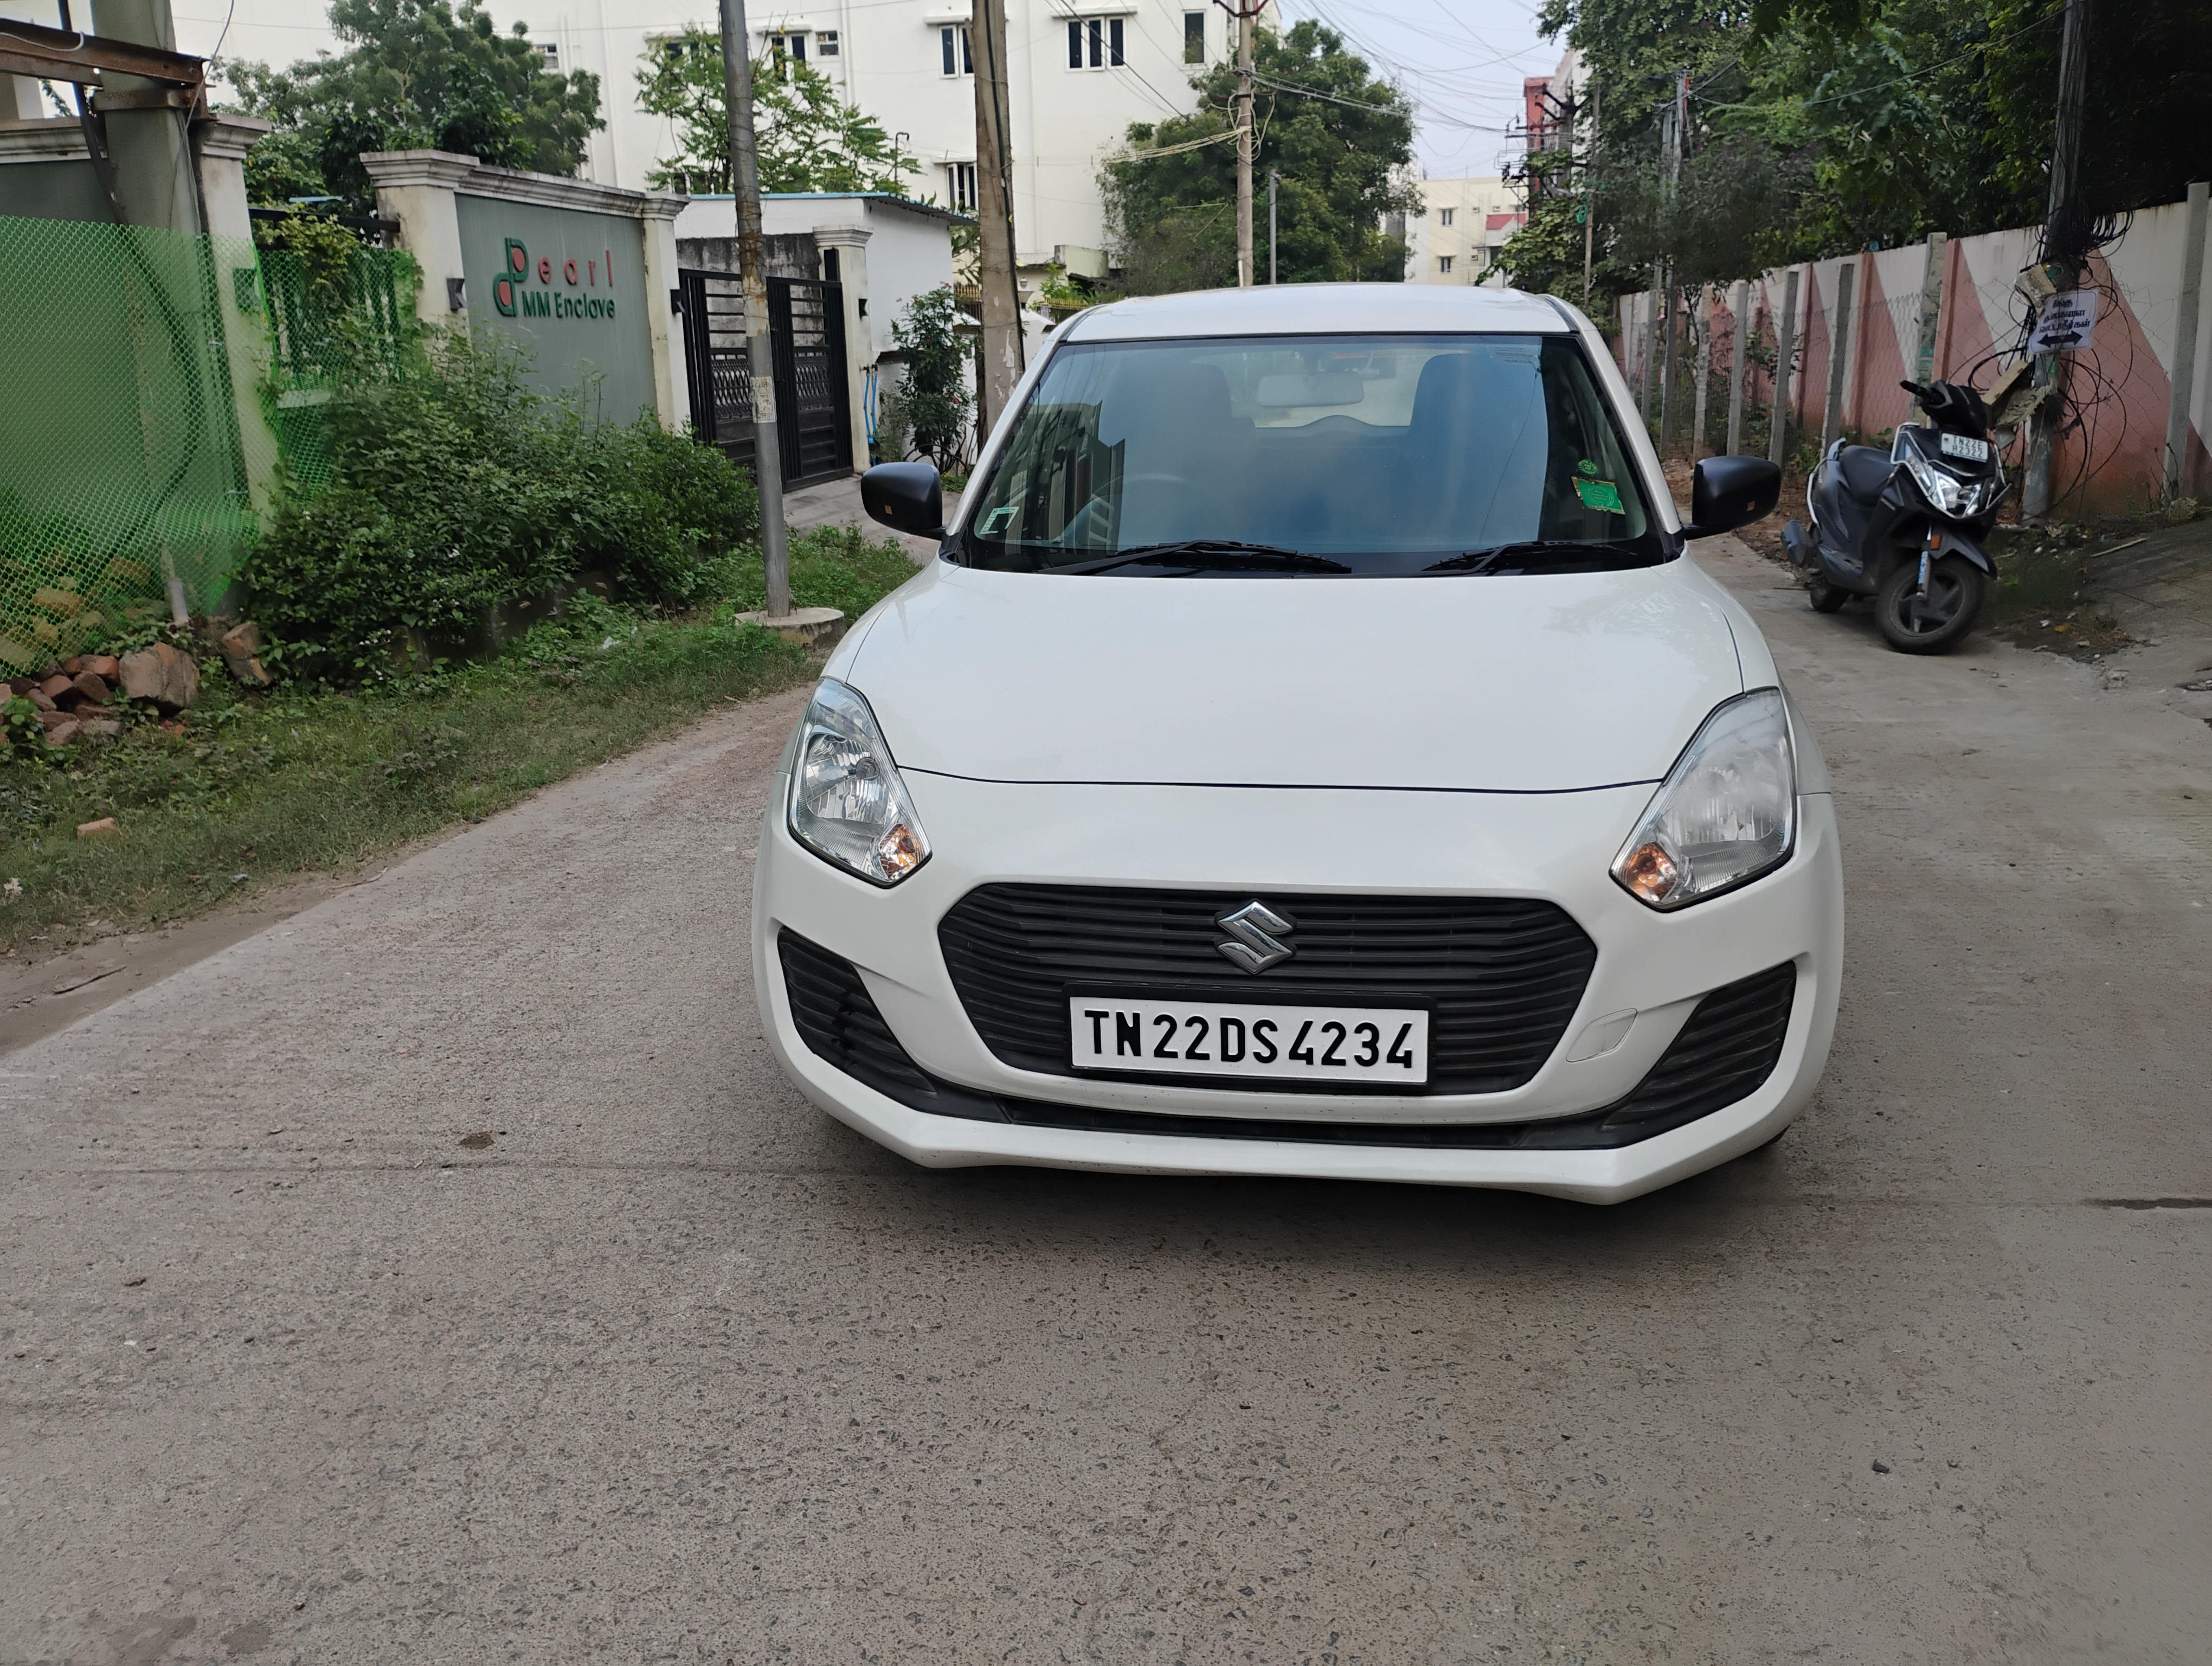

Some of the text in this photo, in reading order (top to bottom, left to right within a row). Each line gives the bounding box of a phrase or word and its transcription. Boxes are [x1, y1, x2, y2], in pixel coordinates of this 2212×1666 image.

[504, 237, 613, 316] Pearl
[522, 291, 615, 318] MM Enclave
[1952, 444, 1983, 458] H2322
[1953, 436, 1983, 450] TN22E
[1084, 1010, 1412, 1068] TN22DS4234
